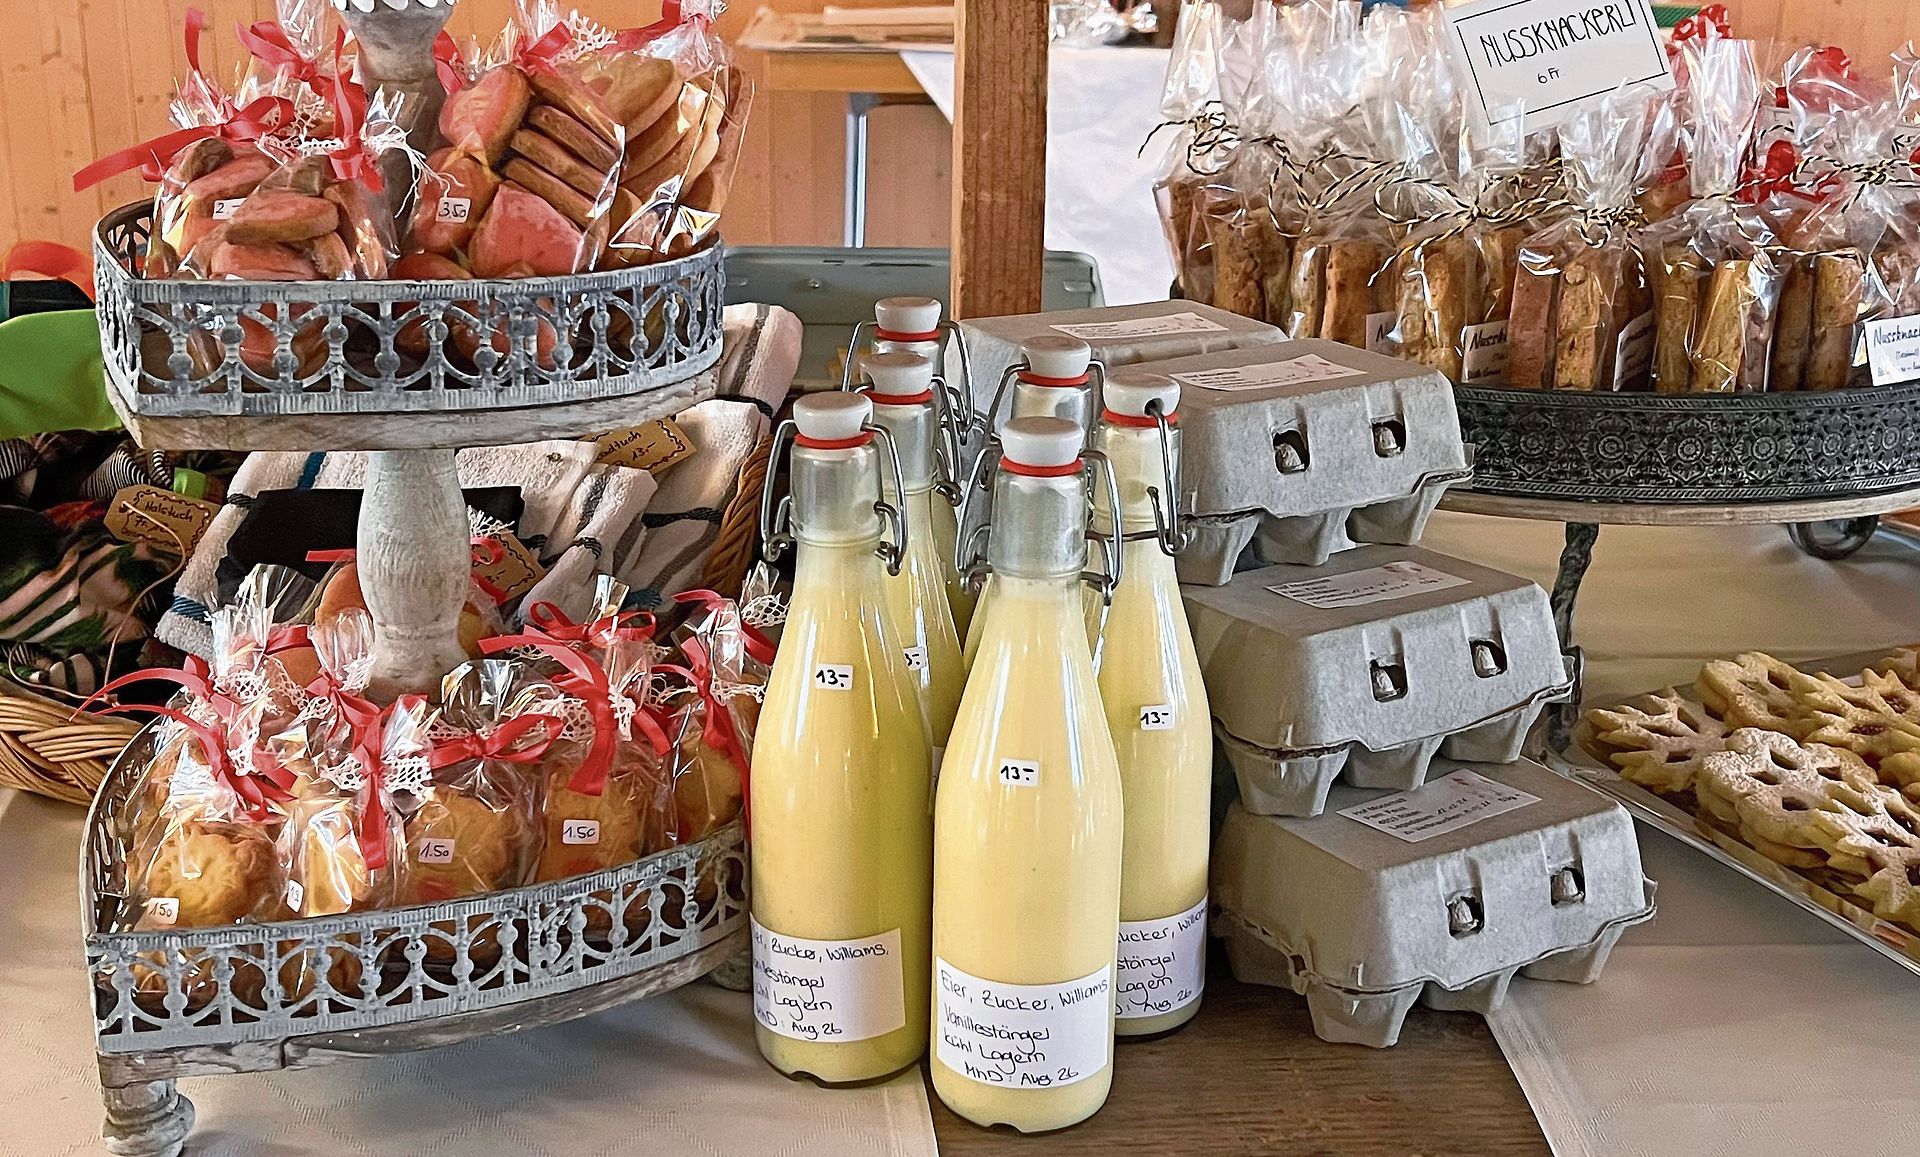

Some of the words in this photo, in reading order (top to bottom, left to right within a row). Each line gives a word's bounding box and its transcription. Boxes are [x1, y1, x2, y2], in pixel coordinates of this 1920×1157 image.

[1537, 73, 1548, 84] 6
[815, 669, 849, 688] 13.-
[1140, 711, 1169, 726] 13.-
[1000, 766, 1034, 781] 13.-
[420, 841, 450, 858] 1.50
[1118, 927, 1175, 943] ucker,
[981, 989, 1054, 1011] Zucker,
[1058, 979, 1108, 1008] Williams
[1176, 988, 1193, 1002] 26
[821, 1022, 843, 1035] 26
[944, 1002, 1050, 1055] Vanillestängel
[978, 1043, 1046, 1075] Lagern
[1057, 1067, 1079, 1081] 26
